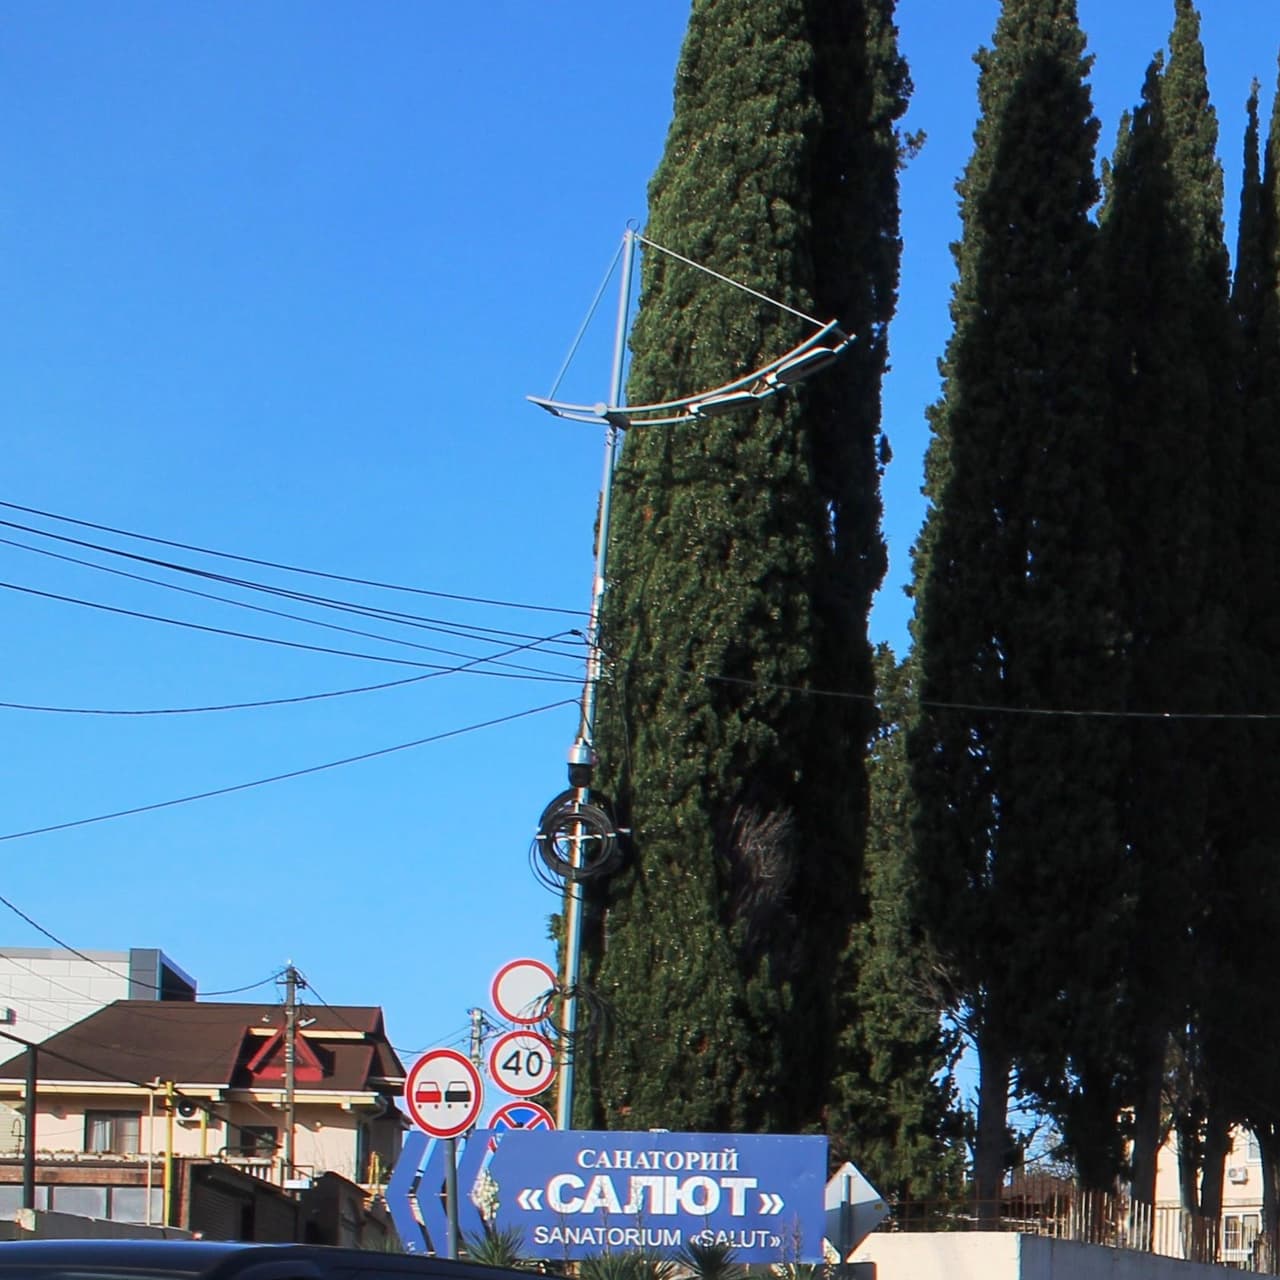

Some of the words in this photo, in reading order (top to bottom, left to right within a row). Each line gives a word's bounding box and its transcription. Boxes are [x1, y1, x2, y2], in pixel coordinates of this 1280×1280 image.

[501, 1049, 544, 1077] 40
[577, 1146, 739, 1172] САНАТОРИЙ
[516, 1173, 785, 1217] «САЛЮТ»
[533, 1226, 682, 1247] SANATORIUM
[689, 1227, 782, 1249] «SALUT»
